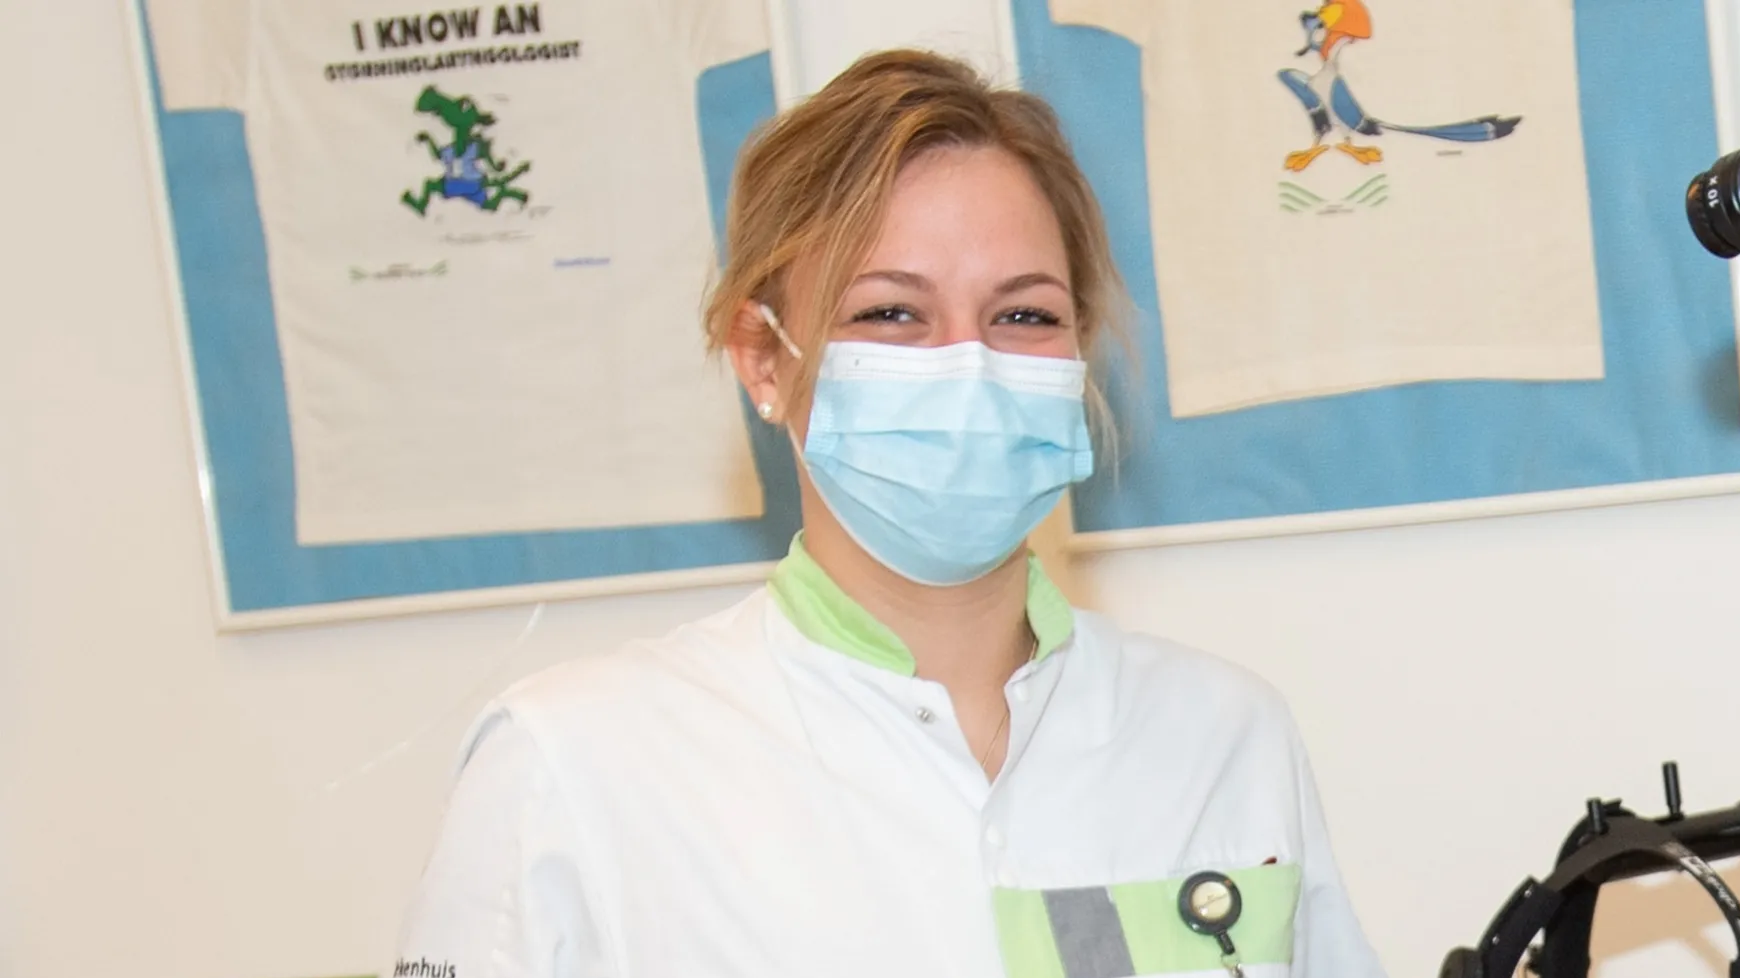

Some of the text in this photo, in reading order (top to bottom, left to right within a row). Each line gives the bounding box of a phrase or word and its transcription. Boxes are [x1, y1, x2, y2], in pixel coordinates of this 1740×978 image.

[352, 2, 541, 51] I KNOW AN
